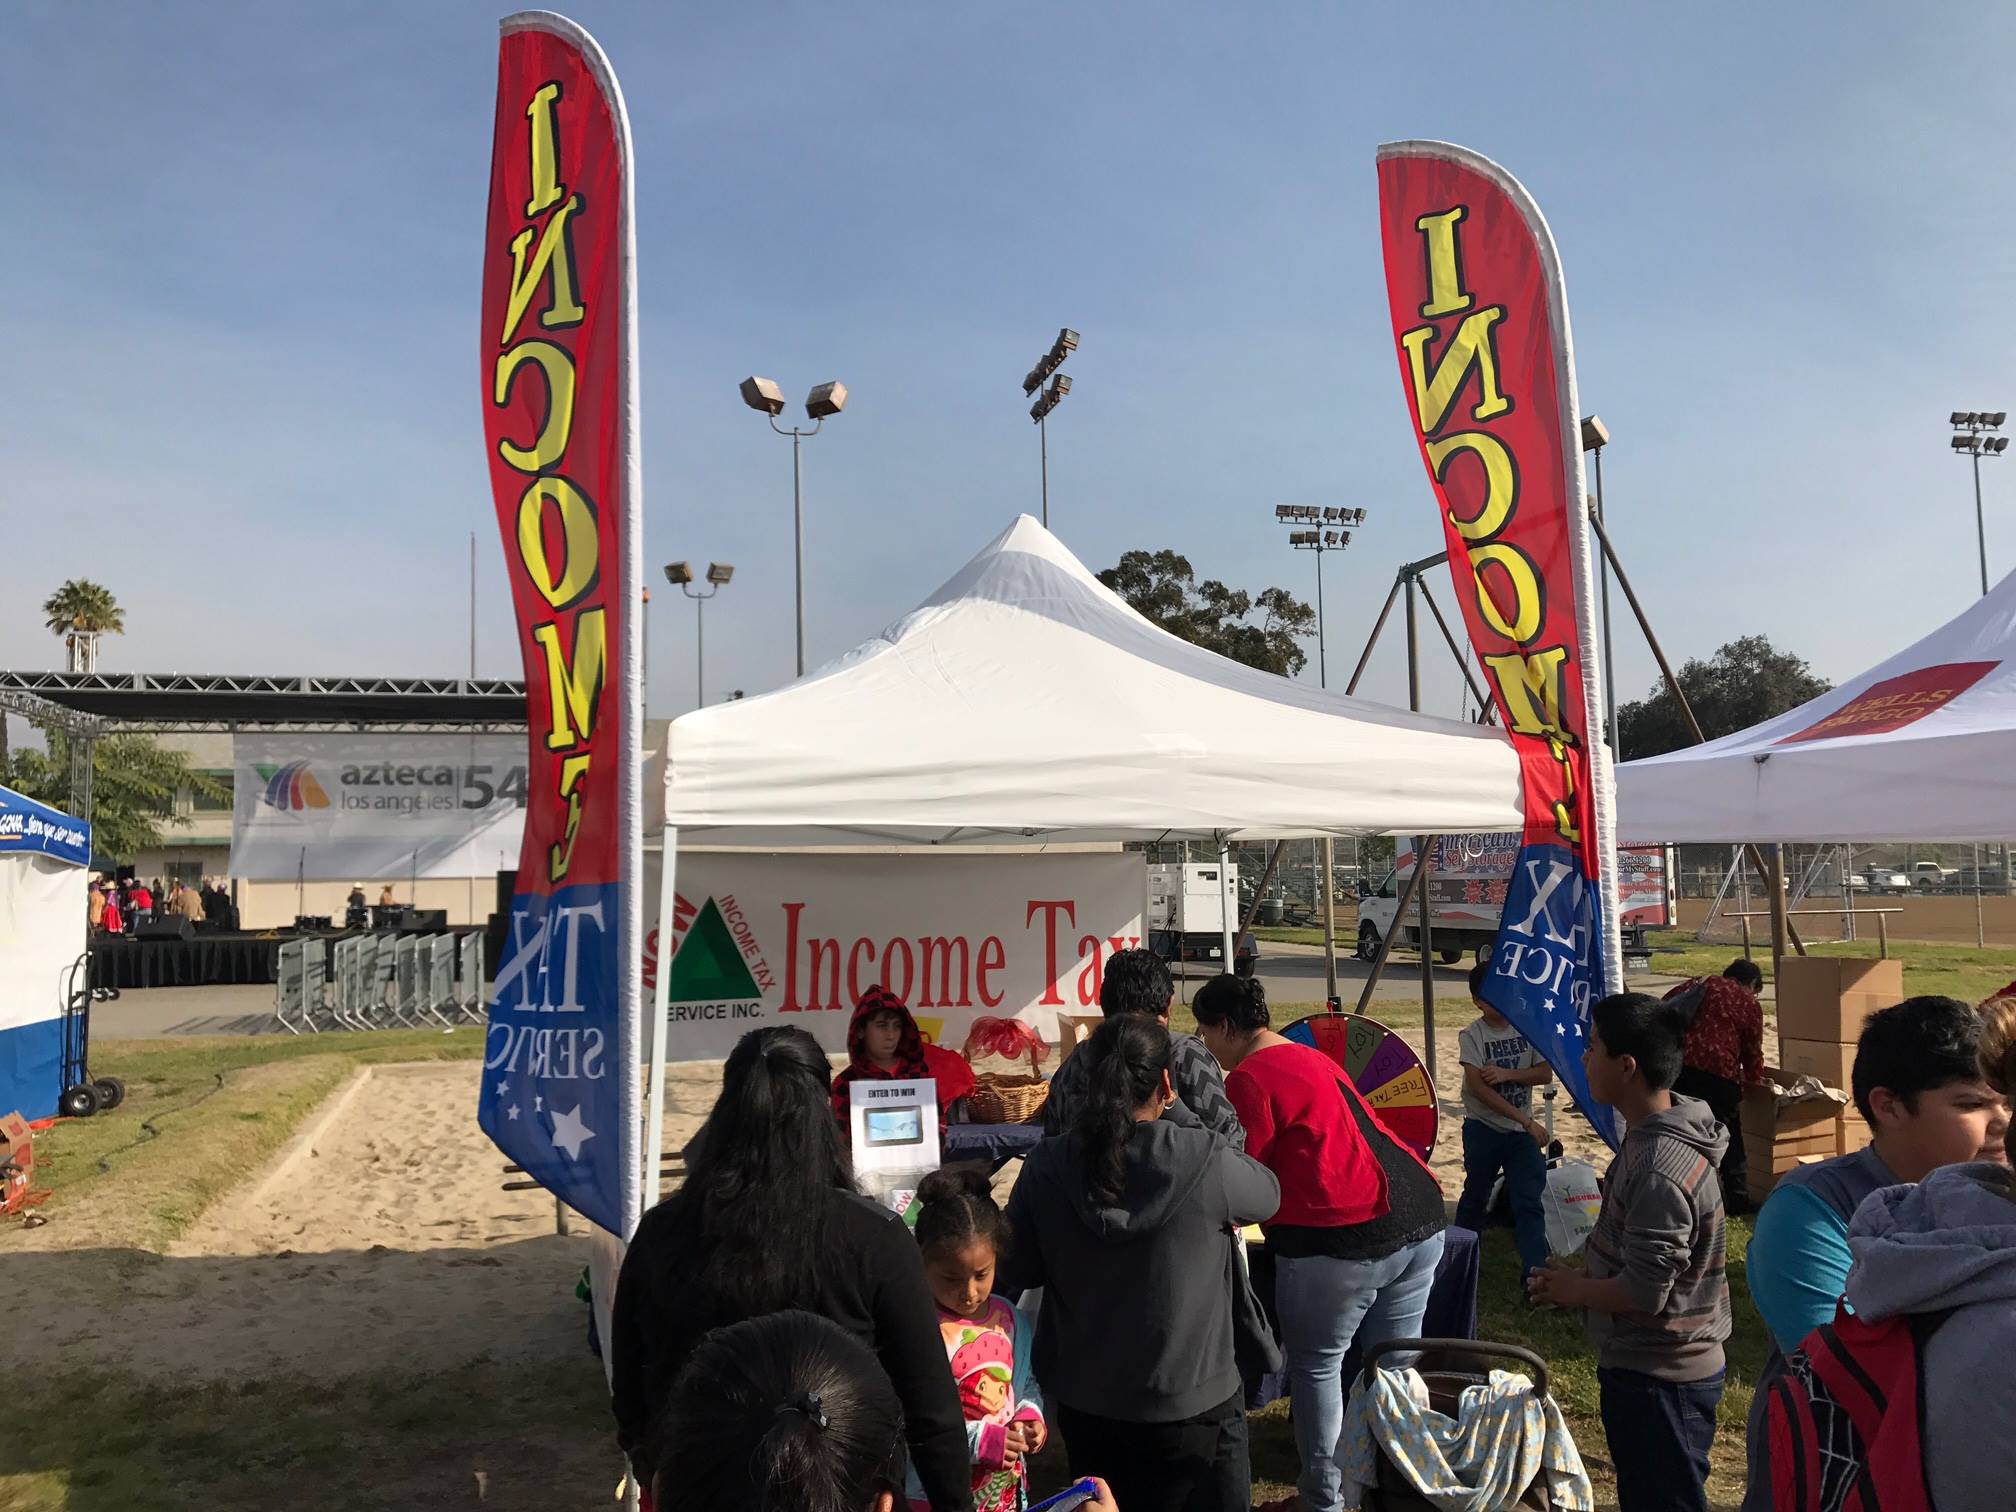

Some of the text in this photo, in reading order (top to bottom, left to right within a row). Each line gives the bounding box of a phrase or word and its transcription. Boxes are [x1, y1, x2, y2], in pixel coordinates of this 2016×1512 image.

[1841, 689, 1953, 714] WELLS
[341, 761, 453, 786] azteca
[462, 765, 528, 809] 54
[341, 791, 453, 814] los angeles
[719, 894, 777, 992] INCOME TAX
[778, 899, 1141, 1012] Income Ta
[667, 1002, 765, 1021] ERVICE INC.
[868, 1087, 916, 1098] ENTER TO WIN
[1392, 1077, 1427, 1098] FREE
[896, 1192, 912, 1213] OW
